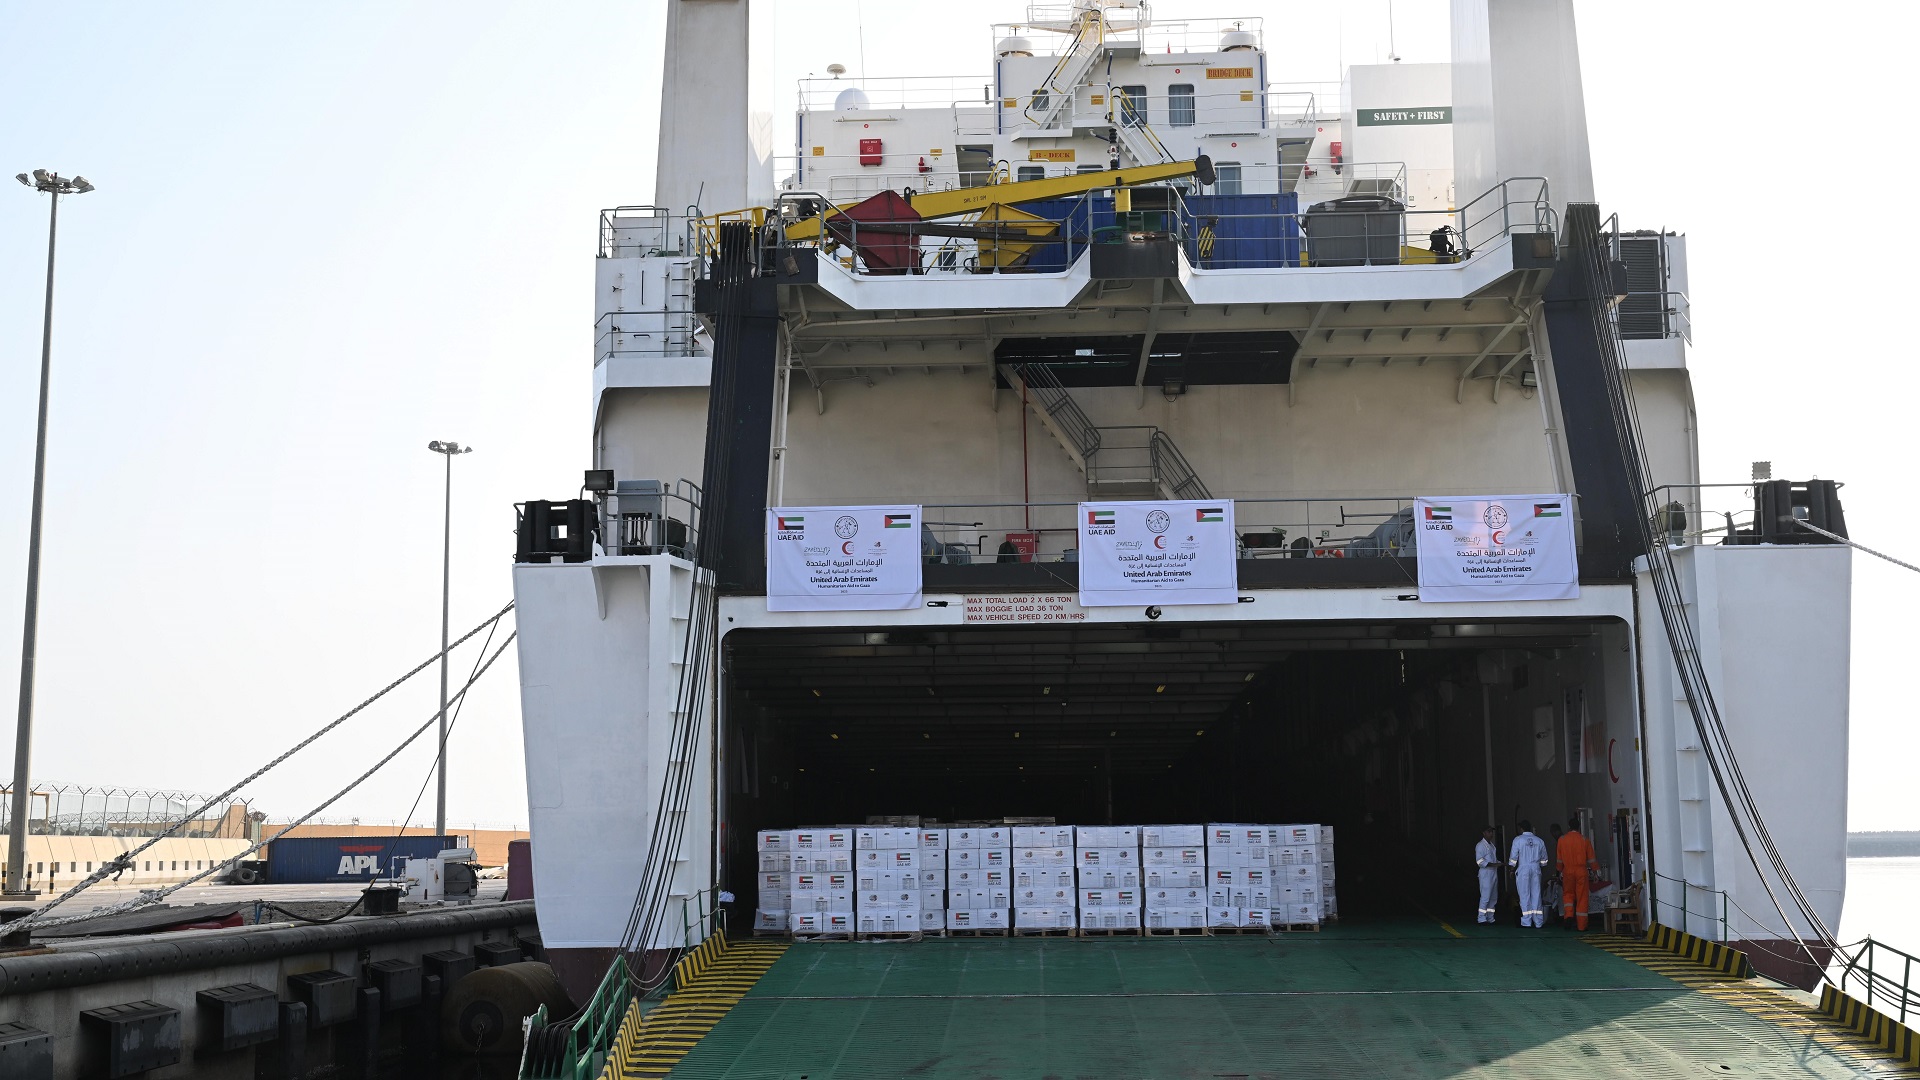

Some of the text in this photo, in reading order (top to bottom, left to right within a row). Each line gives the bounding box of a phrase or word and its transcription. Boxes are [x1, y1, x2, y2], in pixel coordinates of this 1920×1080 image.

[1374, 112, 1408, 120] SAFETY
[1418, 111, 1445, 119] FIRST
[1484, 549, 1505, 557] العربية
[1508, 548, 1535, 557] الإمارات
[1169, 553, 1196, 561] الإمارات
[856, 559, 882, 567] الإمارات
[337, 855, 384, 874] APL
